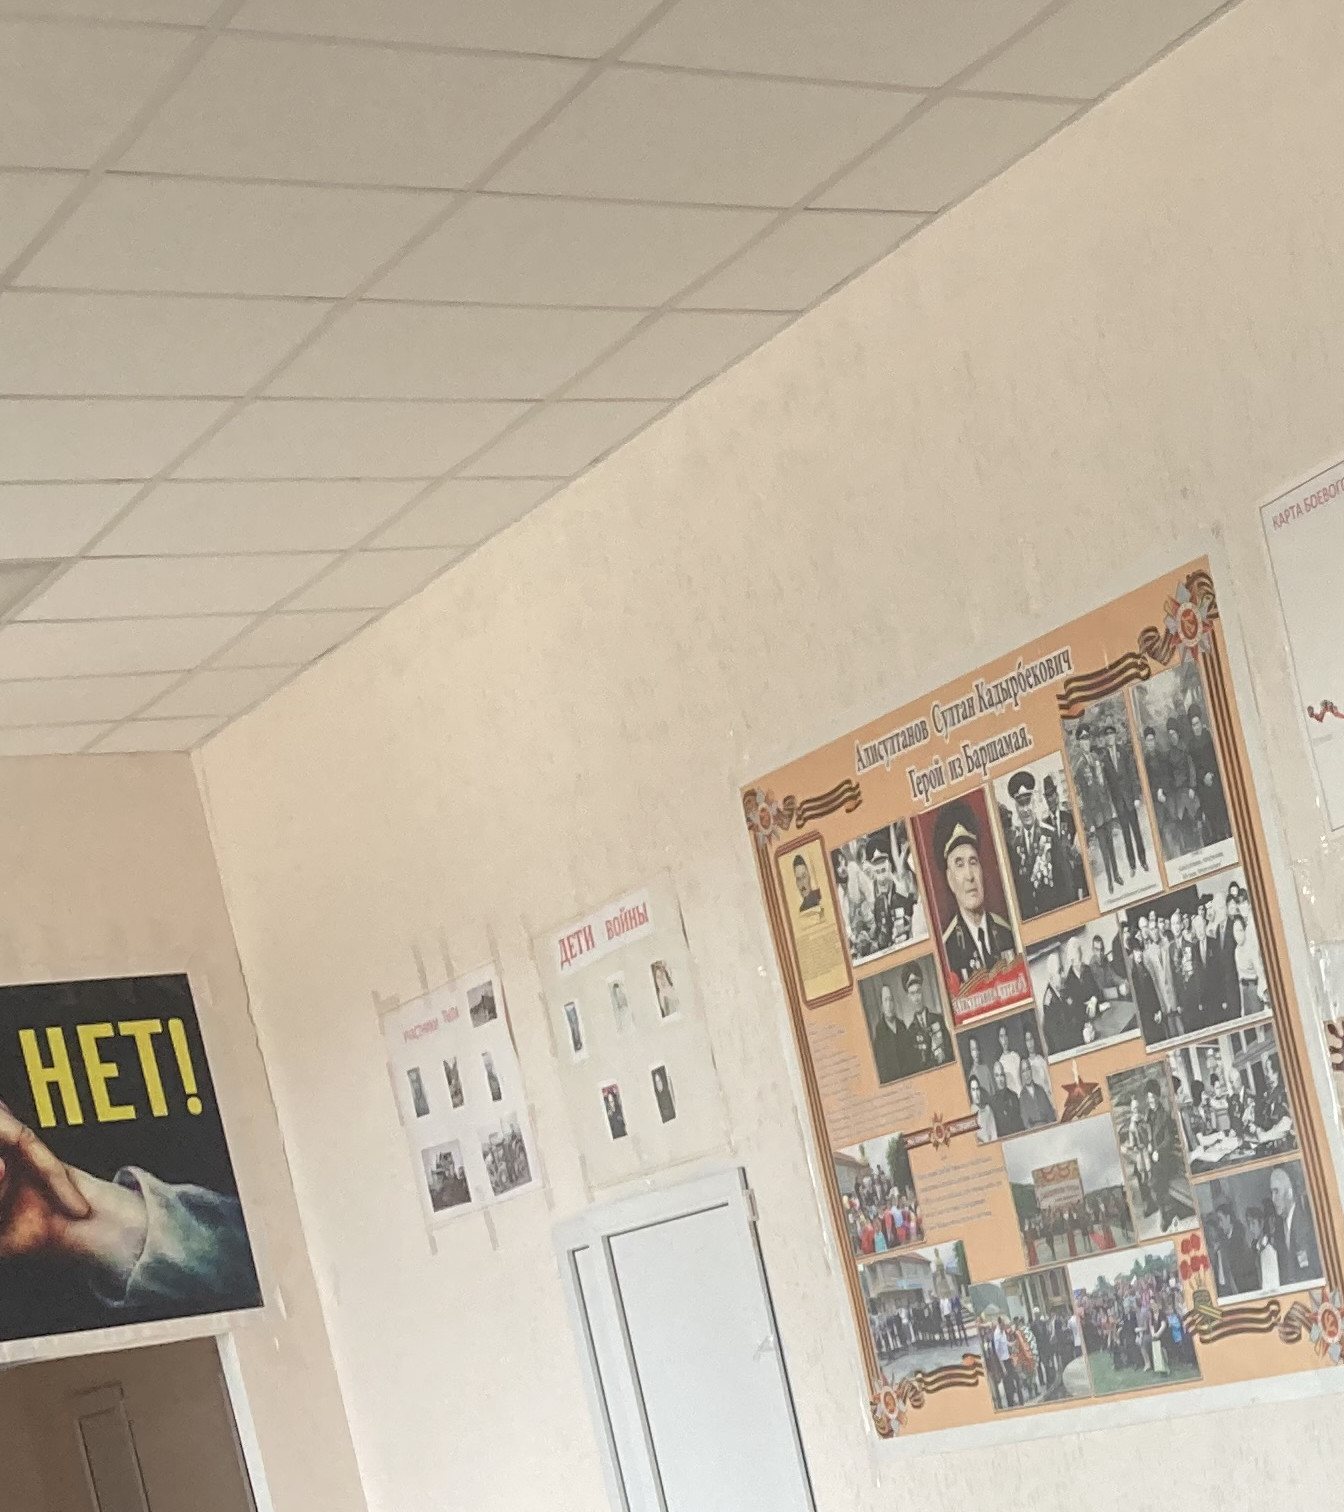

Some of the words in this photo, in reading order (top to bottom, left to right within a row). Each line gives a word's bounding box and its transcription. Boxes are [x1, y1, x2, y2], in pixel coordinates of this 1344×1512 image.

[1272, 503, 1304, 530] КАРТА
[856, 719, 929, 772] Алисултанов
[931, 698, 976, 741] Султан
[975, 649, 1072, 707] Кадырбекович
[908, 758, 945, 802] Герой
[949, 760, 965, 780] из
[558, 924, 595, 970] ДЕТИ
[18, 1017, 204, 1128] НЕТ!
